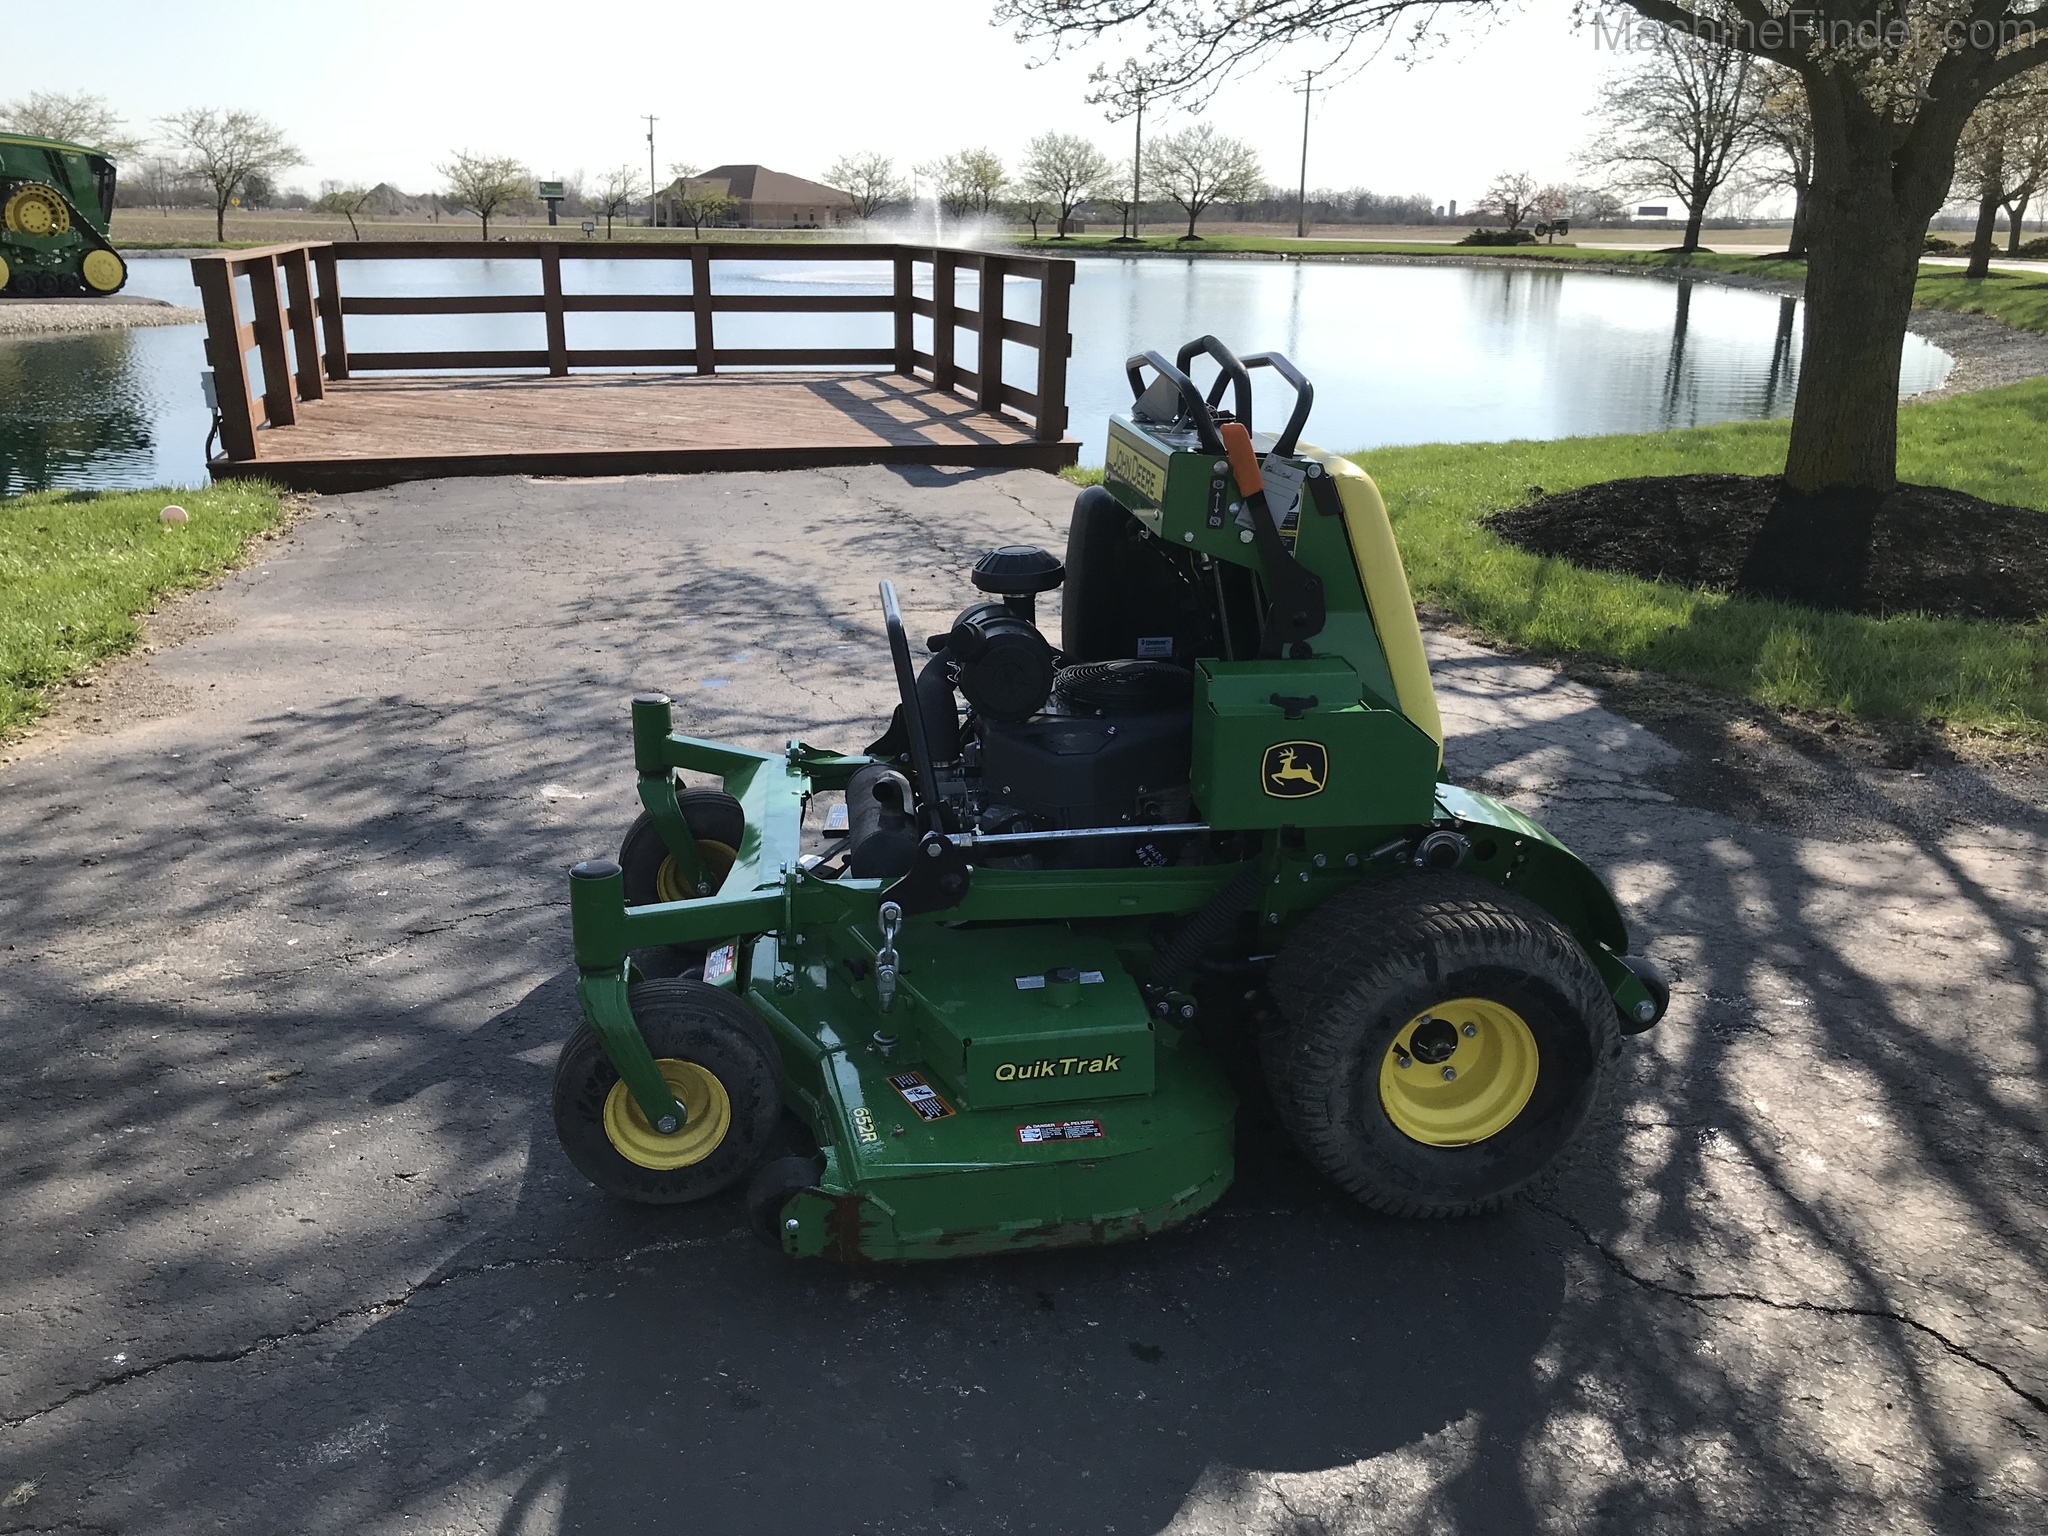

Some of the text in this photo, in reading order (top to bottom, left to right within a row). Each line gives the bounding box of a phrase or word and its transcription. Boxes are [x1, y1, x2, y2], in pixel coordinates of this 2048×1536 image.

[1113, 444, 1156, 497] JOHN DEERE
[853, 1107, 878, 1143] 652R
